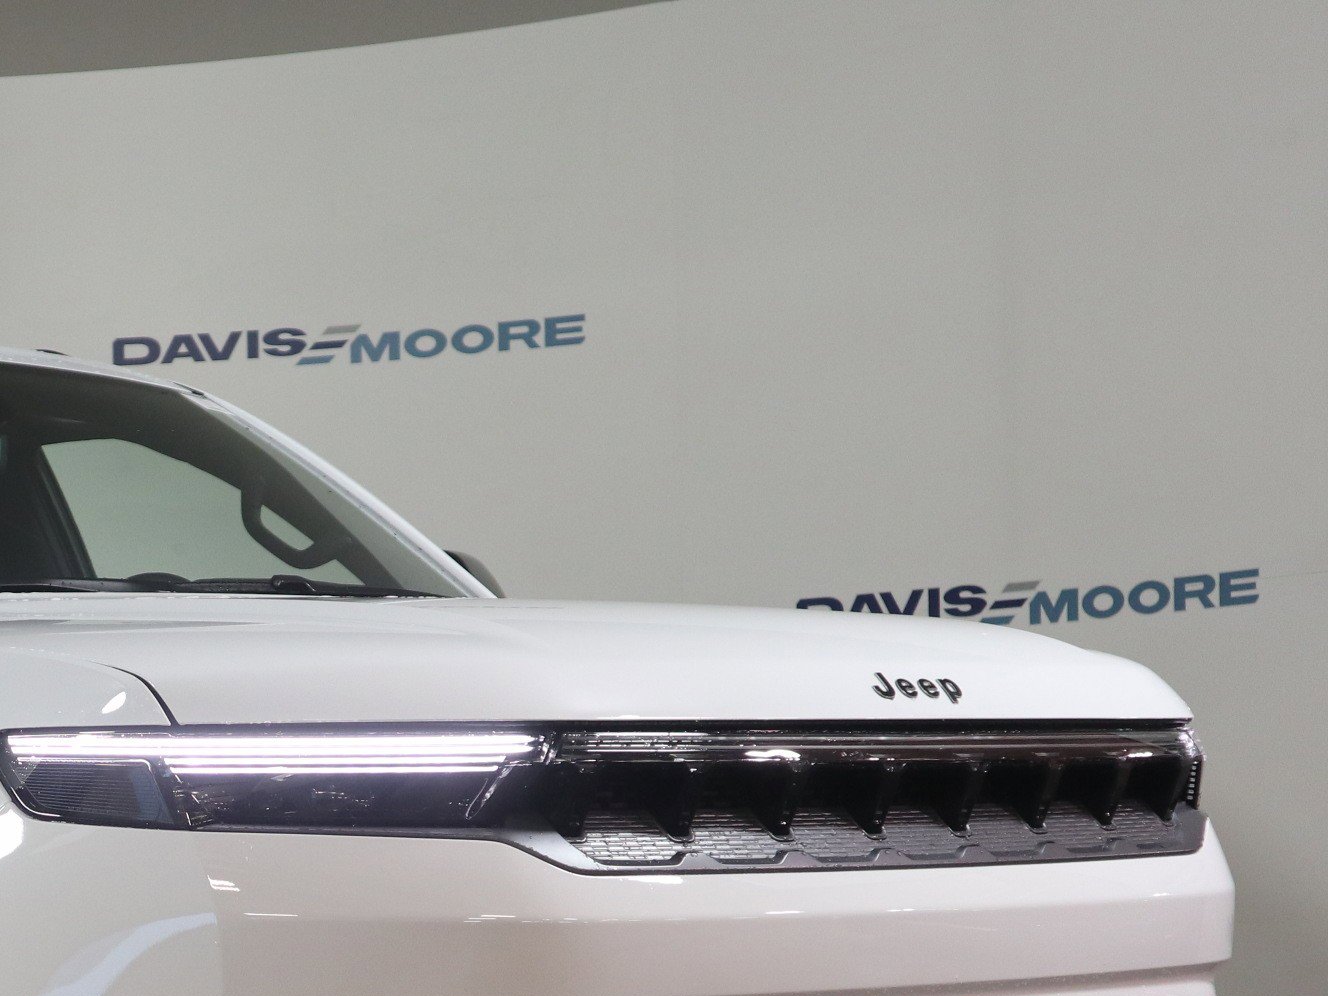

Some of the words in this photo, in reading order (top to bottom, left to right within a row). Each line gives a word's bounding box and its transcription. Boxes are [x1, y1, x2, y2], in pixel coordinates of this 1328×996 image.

[112, 327, 307, 366] DAVIS
[350, 314, 586, 364] MOORE
[1029, 568, 1260, 625] MOORE
[872, 672, 963, 704] Jeep
